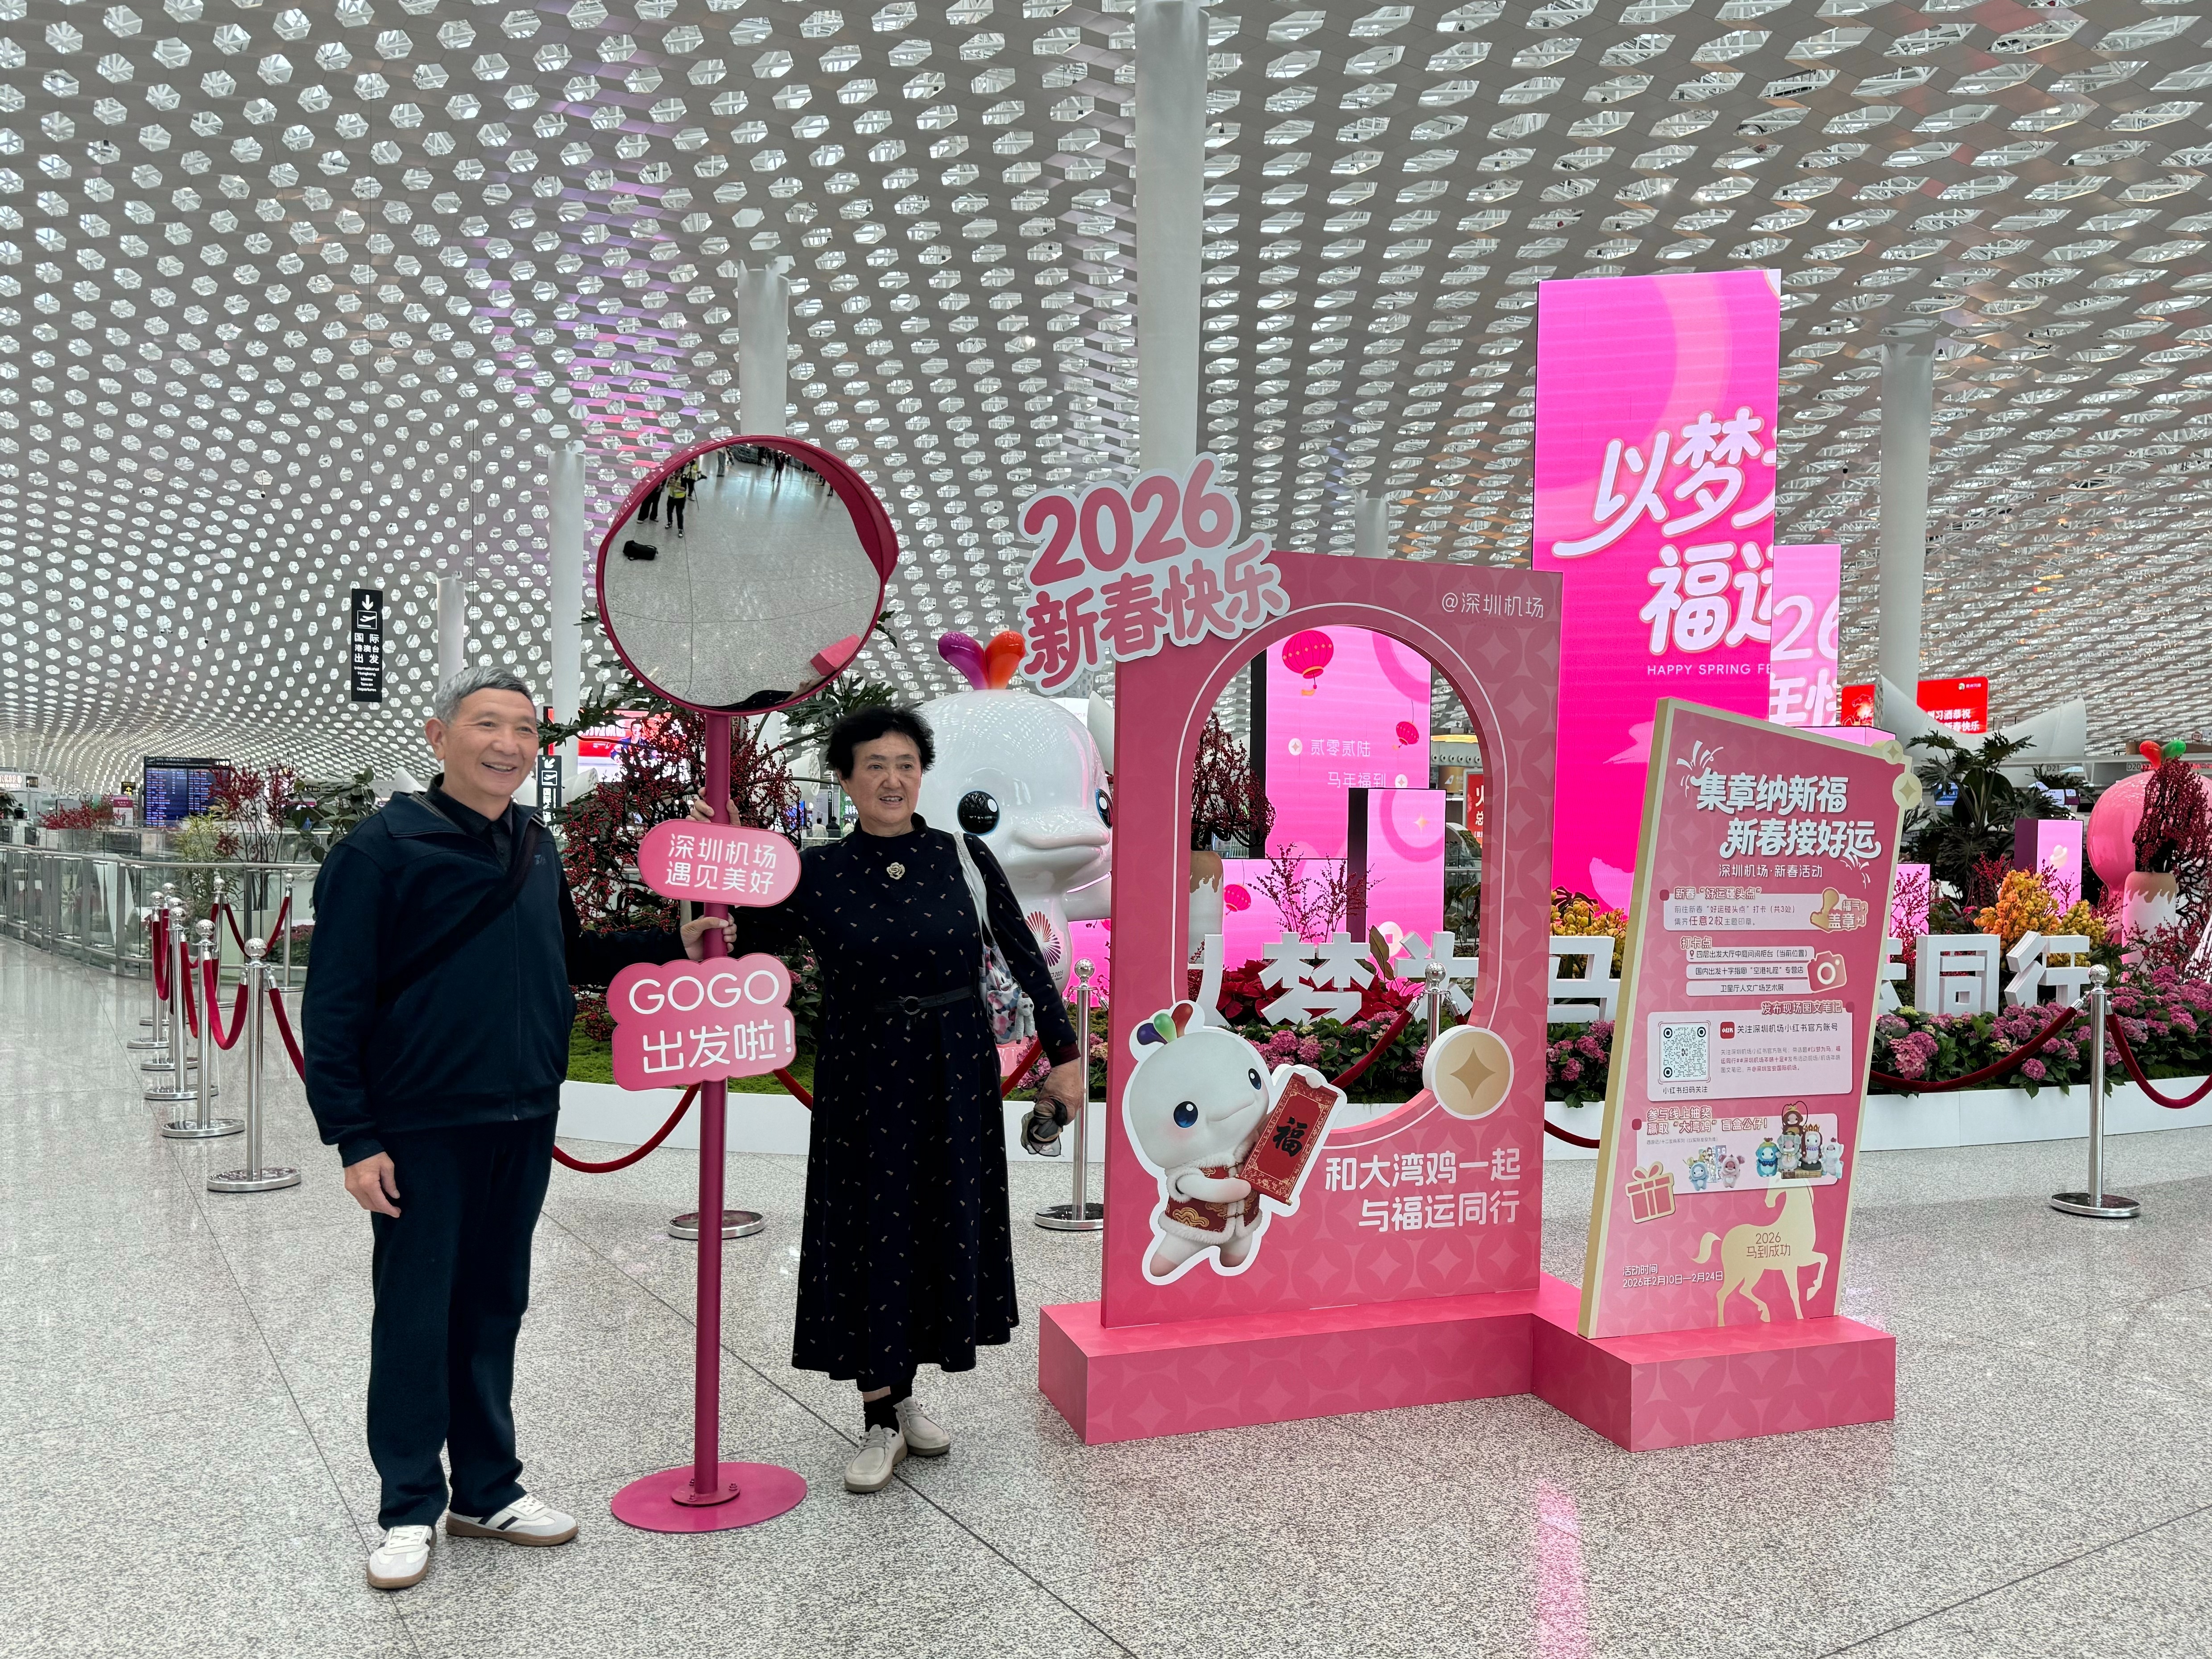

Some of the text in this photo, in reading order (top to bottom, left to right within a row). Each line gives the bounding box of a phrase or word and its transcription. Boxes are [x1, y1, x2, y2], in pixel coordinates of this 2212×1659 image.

[1024, 459, 1234, 586] 2026
[1442, 592, 1544, 619] @深圳机场
[1024, 539, 1283, 688] 新春快乐
[354, 633, 380, 643] 国际
[355, 644, 380, 654] 港澳台
[354, 654, 379, 664] 出发
[1647, 665, 1692, 675] HAPPY
[1699, 664, 1750, 674] SPRING
[1311, 739, 1370, 757] 贰零贰陆
[1327, 772, 1386, 788] 马年福到
[1690, 767, 1849, 815] 集章纳新福
[1720, 817, 1881, 859] 新春接好运
[668, 833, 777, 869] 深圳机场
[665, 861, 774, 895] 遇见美好
[1719, 864, 1823, 878] 深圳机场·新春活动
[1674, 887, 1761, 900] 新春“好运碰头点”
[1681, 937, 1712, 949] 打卡点
[629, 970, 779, 1014] GOGO
[1720, 984, 1784, 993] 卫星厅人文广场艺术展
[1761, 1001, 1842, 1015] 发布现场图文笔记
[1737, 1023, 1838, 1034] 关注深圳机场小红书官方账号
[1662, 1086, 1708, 1094] 小红书扫码关注
[1647, 1107, 1712, 1121] 参与线上抽奖
[1273, 1117, 1308, 1157] 福
[1325, 1148, 1521, 1191] 和大湾鸡一起
[1358, 1190, 1520, 1232] 与福运同行
[1755, 1232, 1782, 1244] 2026
[1746, 1243, 1791, 1258] 马到成功
[1622, 1264, 1658, 1276] 活动时间
